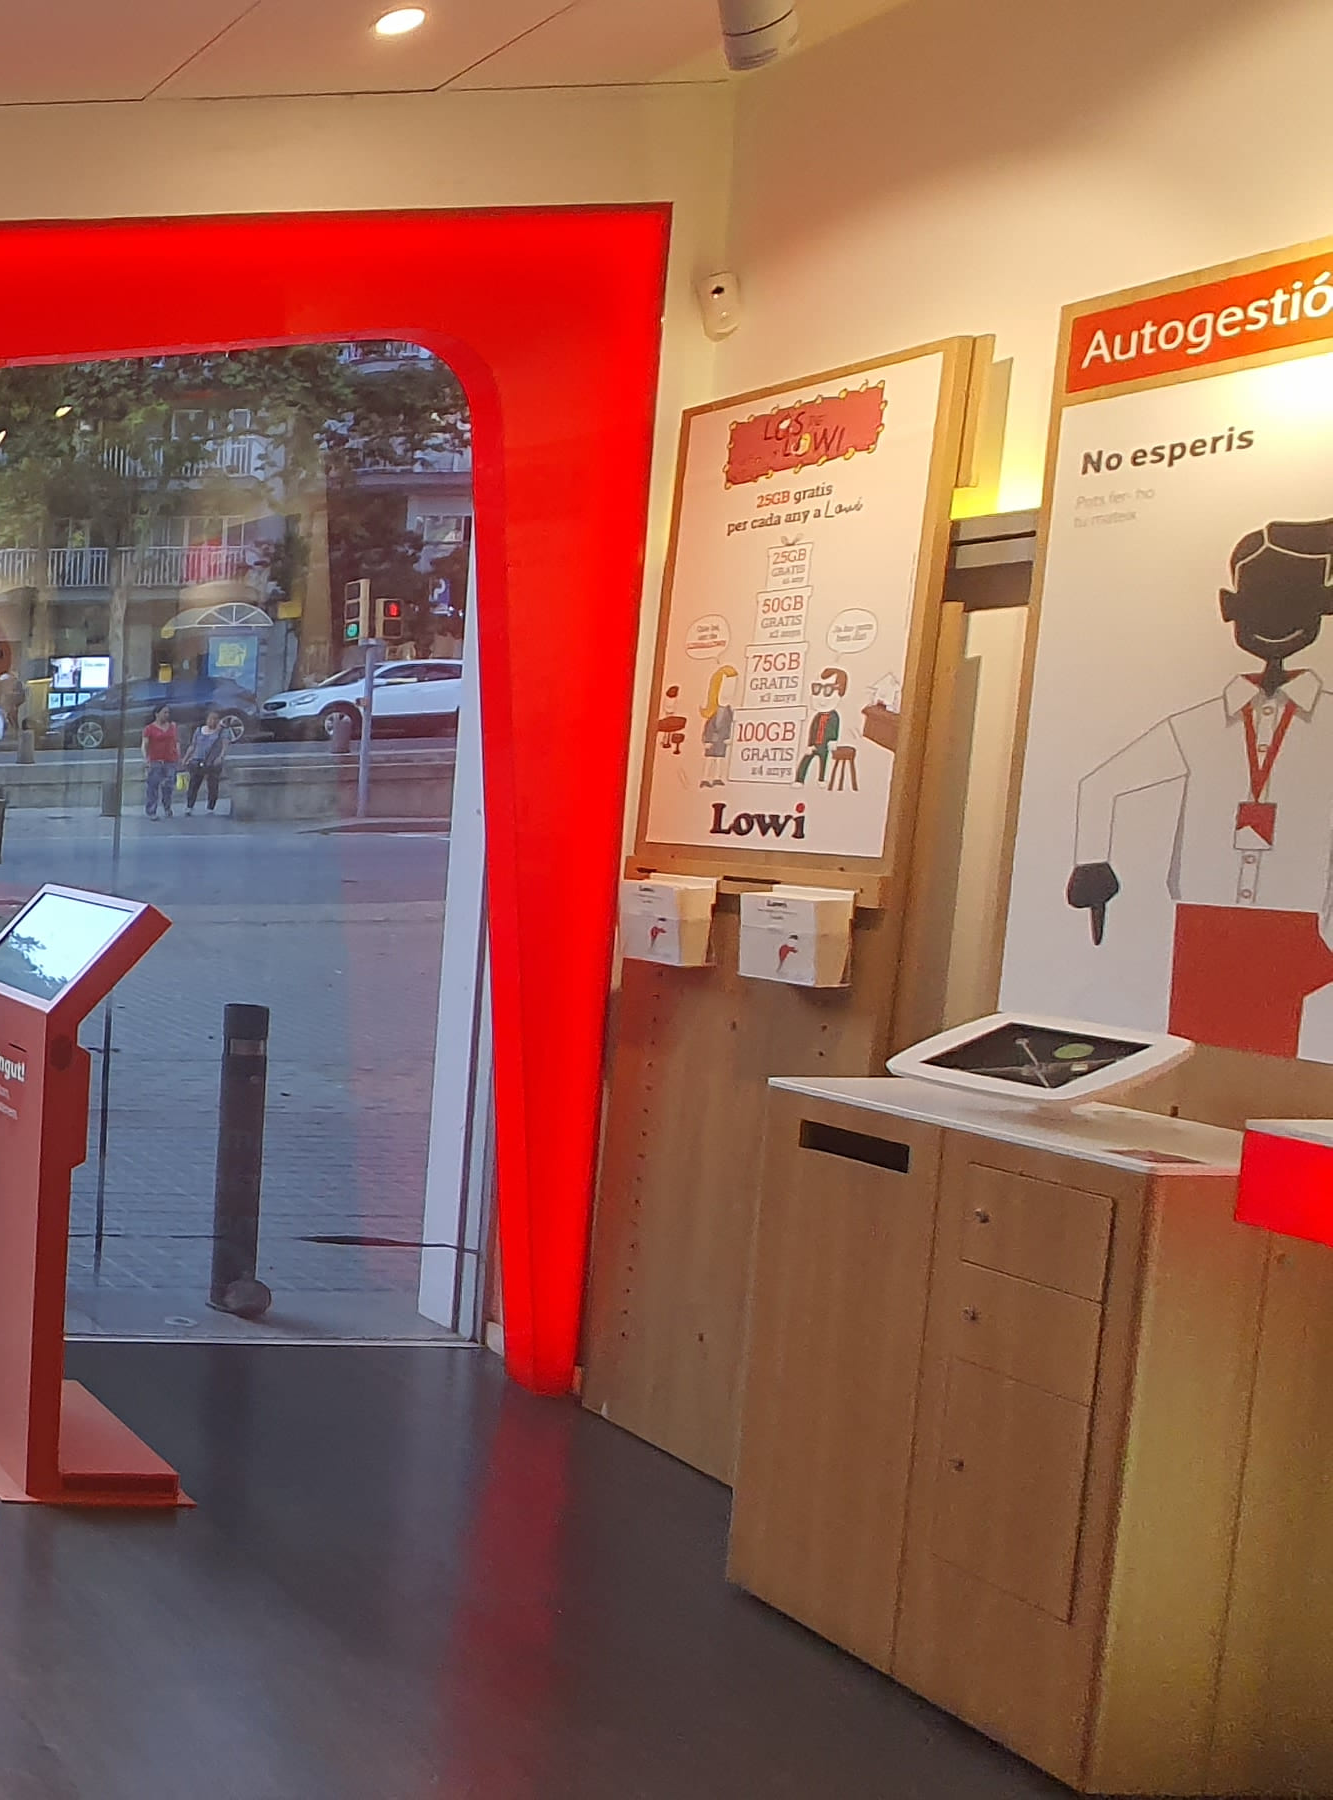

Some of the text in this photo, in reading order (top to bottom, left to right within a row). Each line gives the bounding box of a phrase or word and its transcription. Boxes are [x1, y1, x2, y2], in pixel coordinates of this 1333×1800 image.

[1081, 271, 1333, 369] Autogestió
[1081, 427, 1254, 475] No esperis
[756, 482, 833, 508] 25GB gratis
[727, 520, 749, 536] per
[751, 512, 781, 529] cada
[784, 508, 810, 524] any
[813, 507, 821, 519] a
[773, 548, 807, 565] 25GB
[762, 595, 804, 614] 50GB
[760, 614, 803, 629] GRATIS
[751, 652, 801, 674] 75GB
[749, 676, 799, 690] GRATIS
[736, 722, 796, 742] 100GB
[741, 747, 794, 762] GRATIS
[709, 802, 806, 839] Lowi
